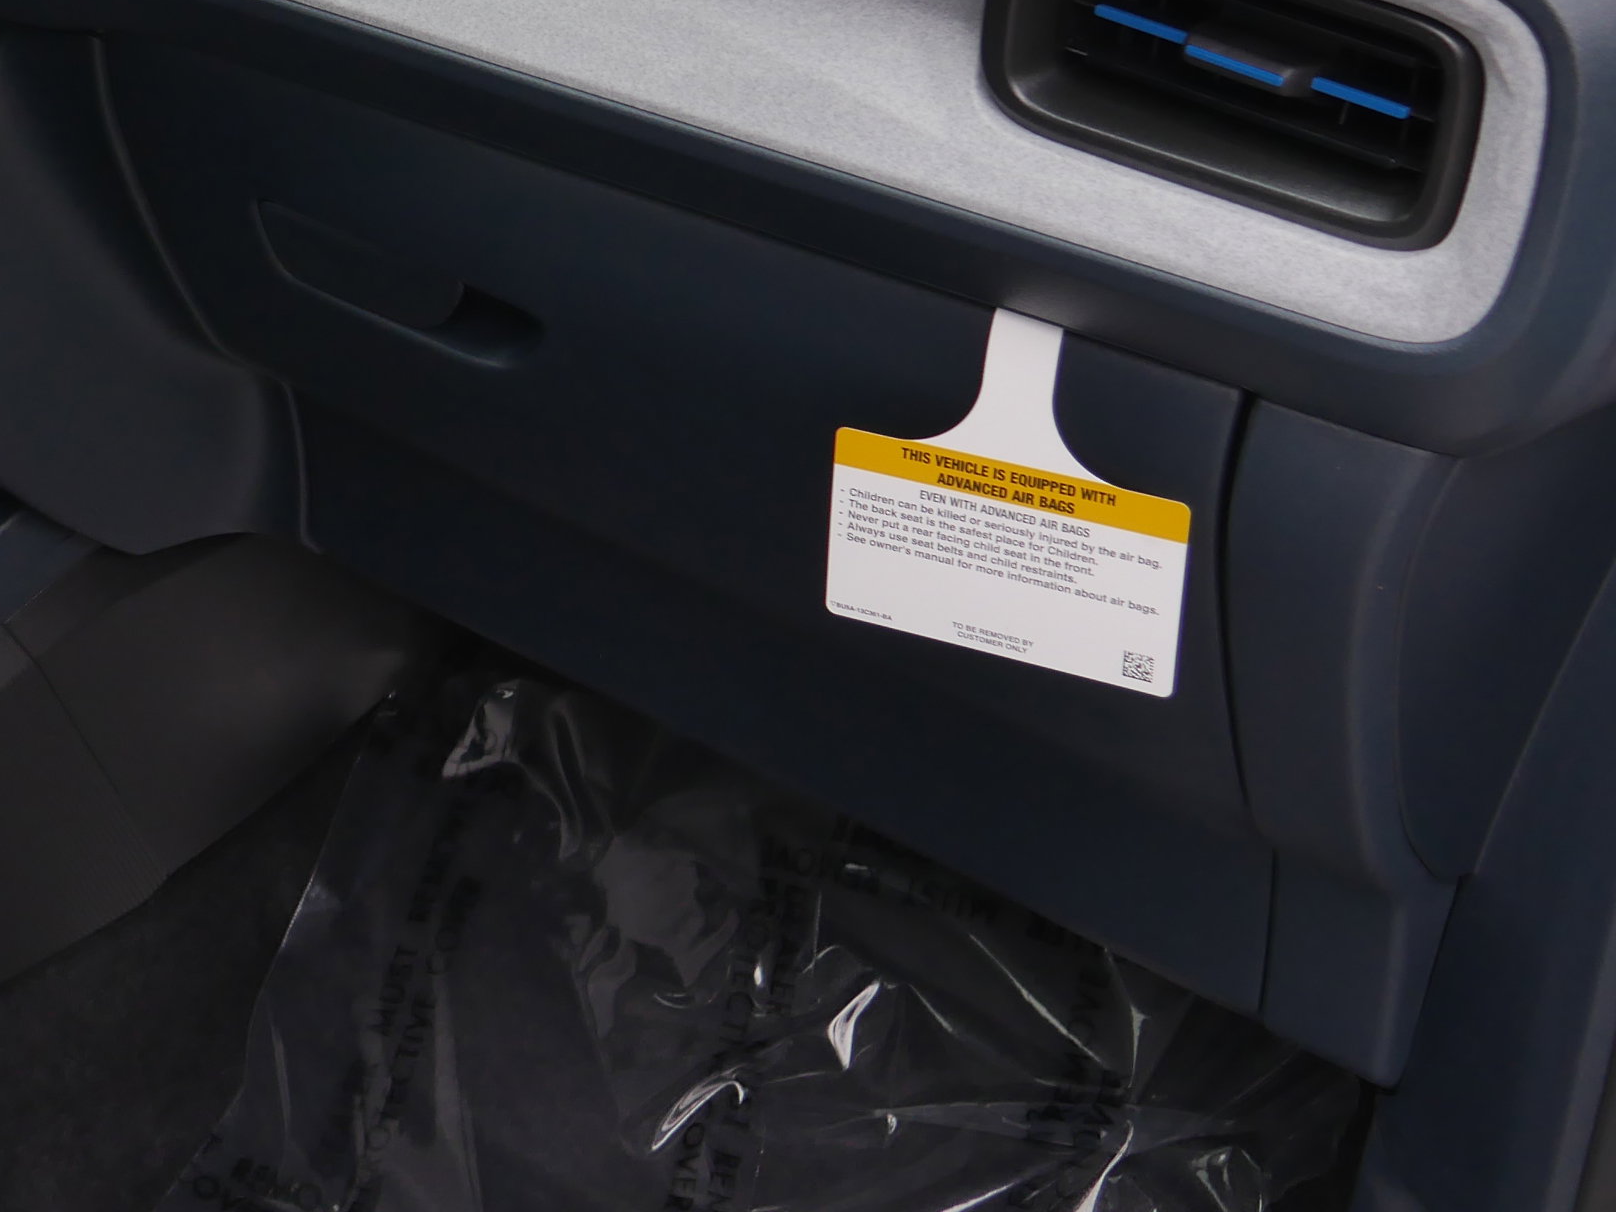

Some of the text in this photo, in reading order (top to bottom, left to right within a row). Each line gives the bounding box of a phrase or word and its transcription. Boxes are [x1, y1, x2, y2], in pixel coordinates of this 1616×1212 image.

[902, 447, 1117, 506] THIS VEHICLE IS EQUIPPED WITH
[937, 473, 1076, 515] ADVANCED AIR BAGS
[848, 510, 879, 525] Never
[882, 519, 903, 531] put
[912, 526, 934, 538] rear
[936, 530, 970, 548] facing
[973, 540, 1000, 554] child
[1004, 548, 1027, 561] seat
[1030, 554, 1041, 564] in
[1044, 557, 1062, 569] the
[1064, 562, 1095, 577] front.
[849, 488, 1163, 570] Children can be killed or seriously injured by the air bag.
[849, 498, 1099, 566] The back seat is the safest place for Children.
[920, 490, 1091, 538] EVEN WITH ADVANCED AIR BAGS
[846, 532, 1160, 616] See owner's manual for more information about air bags.
[847, 521, 1078, 584] Always use seat belts and child restraints.
[952, 621, 1034, 648] TO BE REMOVED BY
[957, 631, 1028, 654] CUSTOMER ONLY
